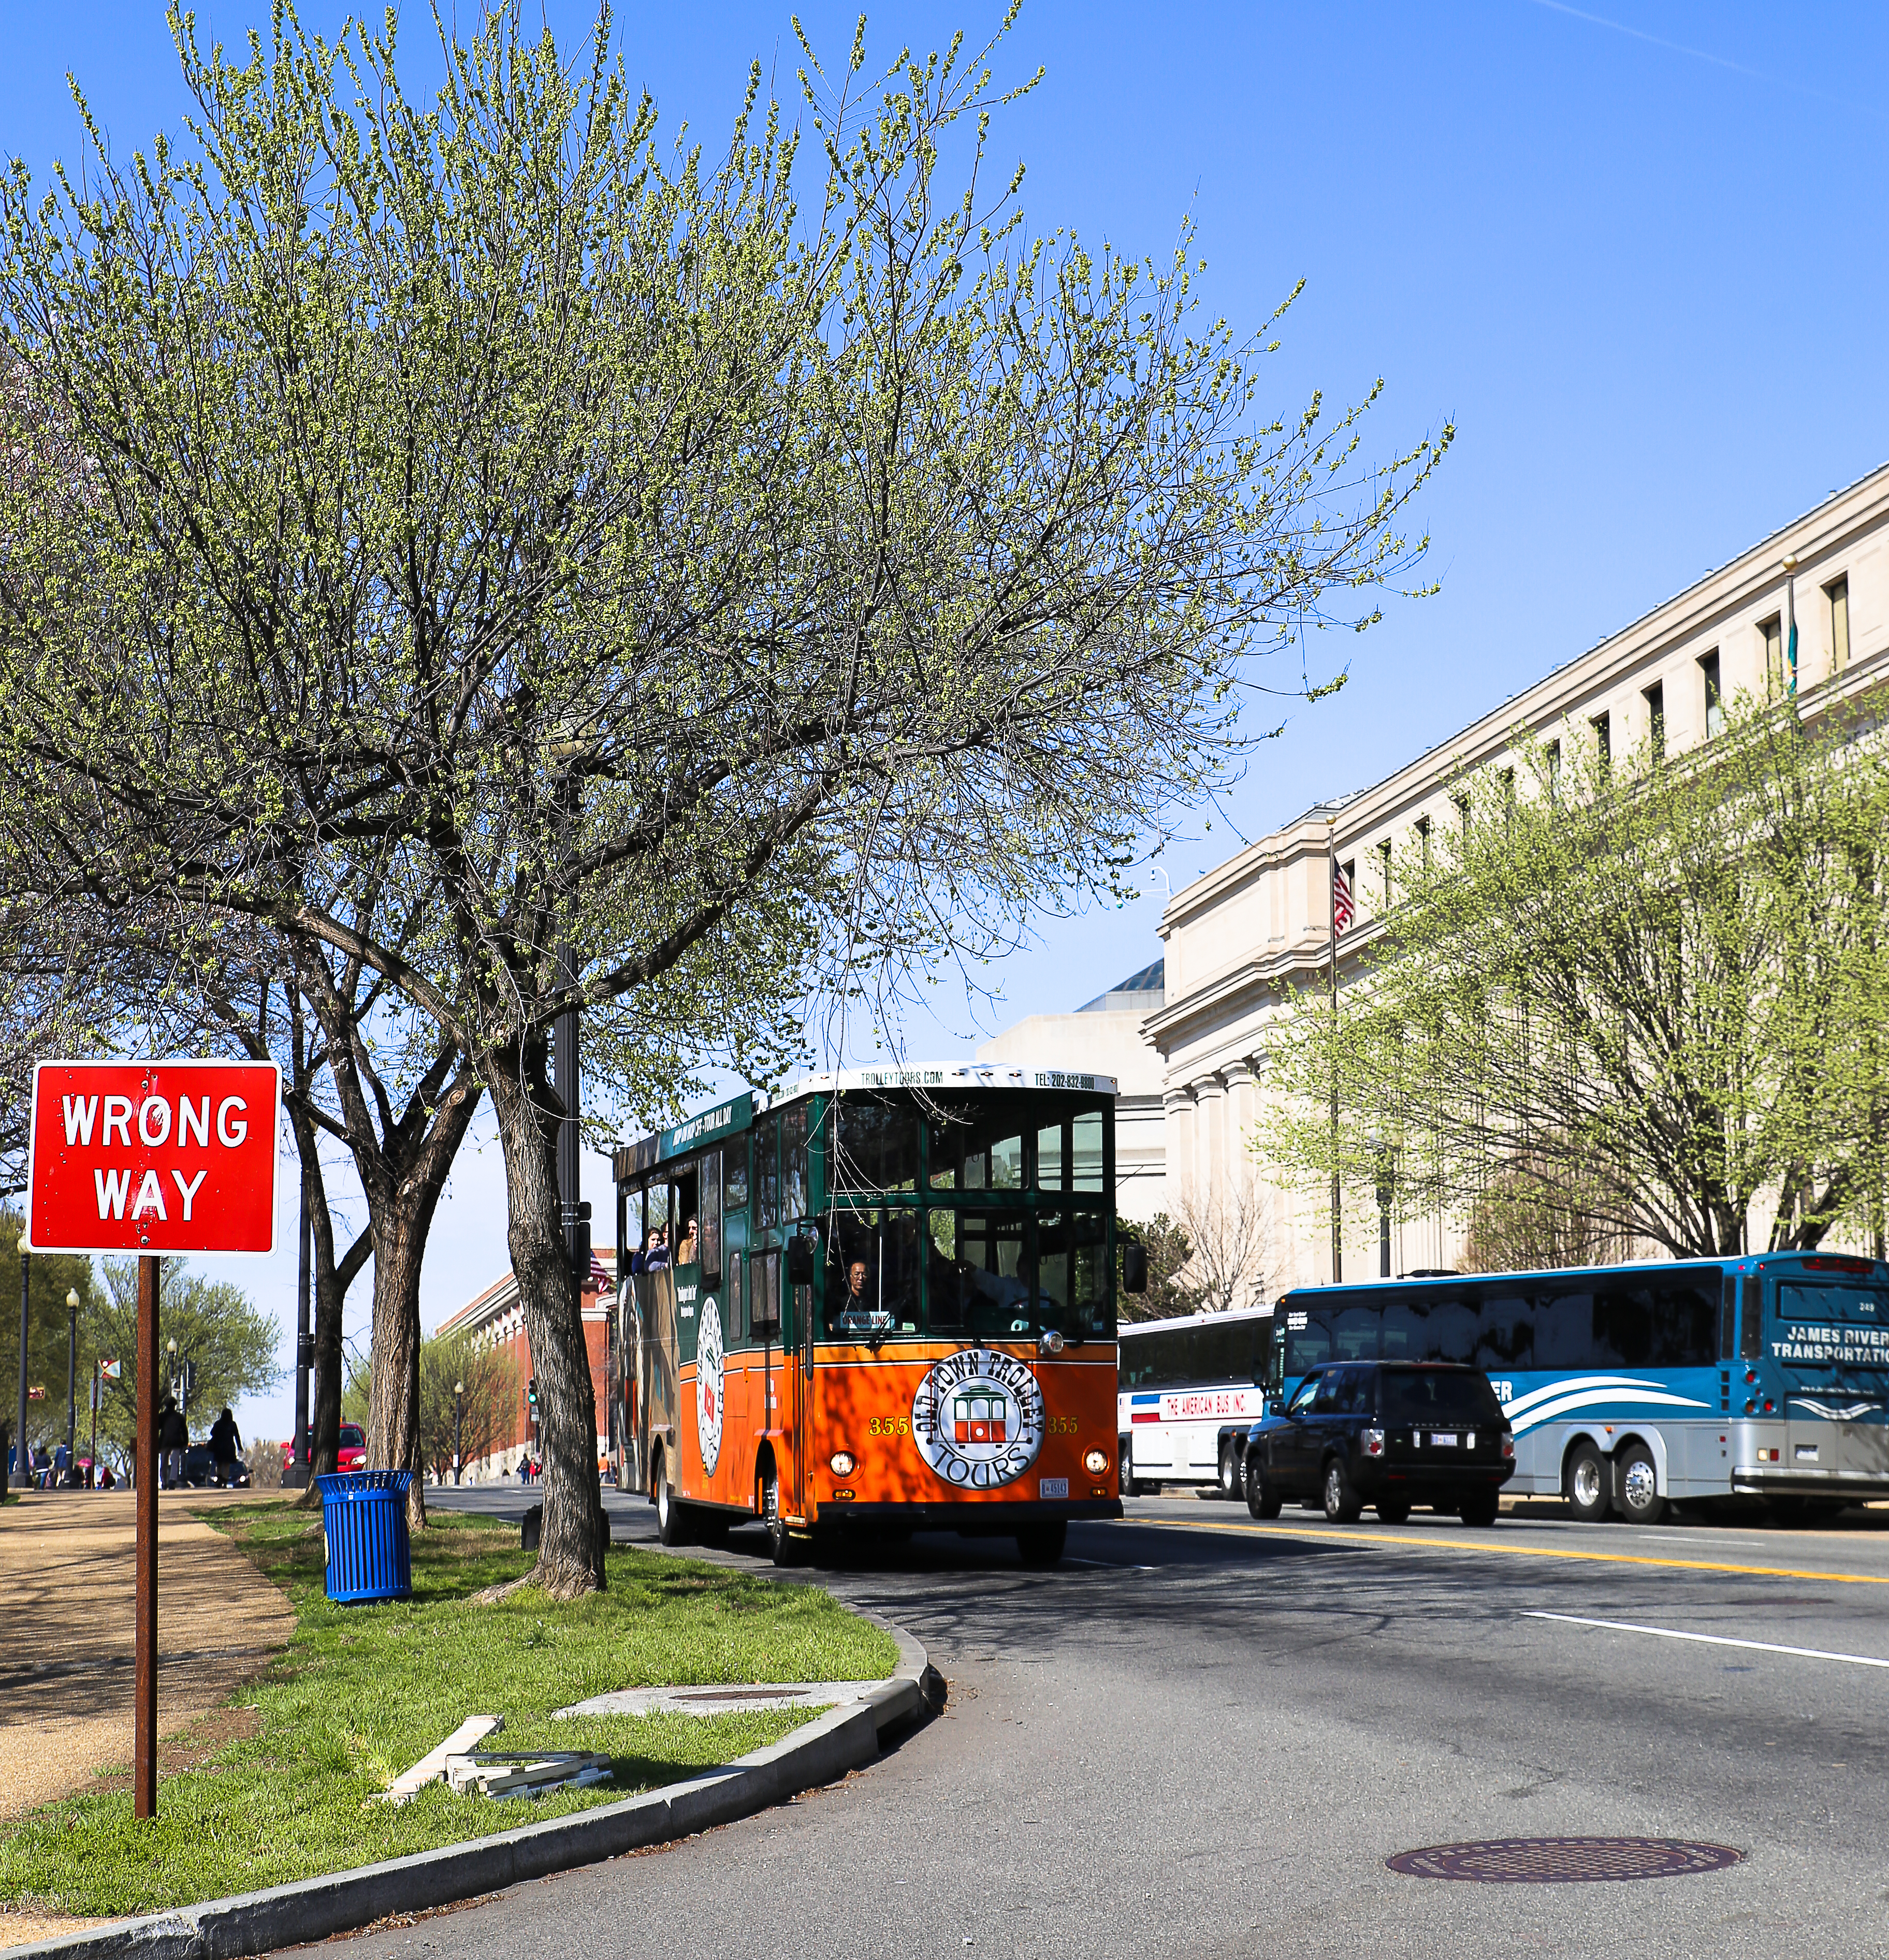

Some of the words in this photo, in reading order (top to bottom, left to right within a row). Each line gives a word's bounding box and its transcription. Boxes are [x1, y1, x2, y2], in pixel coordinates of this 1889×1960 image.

[861, 1072, 943, 1085] TROLLEYTOURS.COM
[1035, 1074, 1050, 1086] TEL:
[1052, 1074, 1095, 1090] 202-832-9800
[62, 1095, 248, 1148] WRONG
[704, 1112, 715, 1133] TOUR
[723, 1105, 732, 1125] DAY
[93, 1168, 208, 1221] WAY
[842, 1315, 870, 1325] ORANGE
[1787, 1326, 1840, 1343] JAMES
[1844, 1329, 1889, 1346] RIVER
[925, 1352, 979, 1394] TOWN
[987, 1352, 1044, 1432] TROLLEY
[915, 1395, 938, 1431] OLD
[1168, 1399, 1178, 1415] THE
[1182, 1396, 1212, 1415] AMERICAN
[1217, 1395, 1229, 1413] BUS
[869, 1416, 909, 1436] 355
[1049, 1416, 1078, 1434] 355
[933, 1443, 1030, 1487] TOURS
